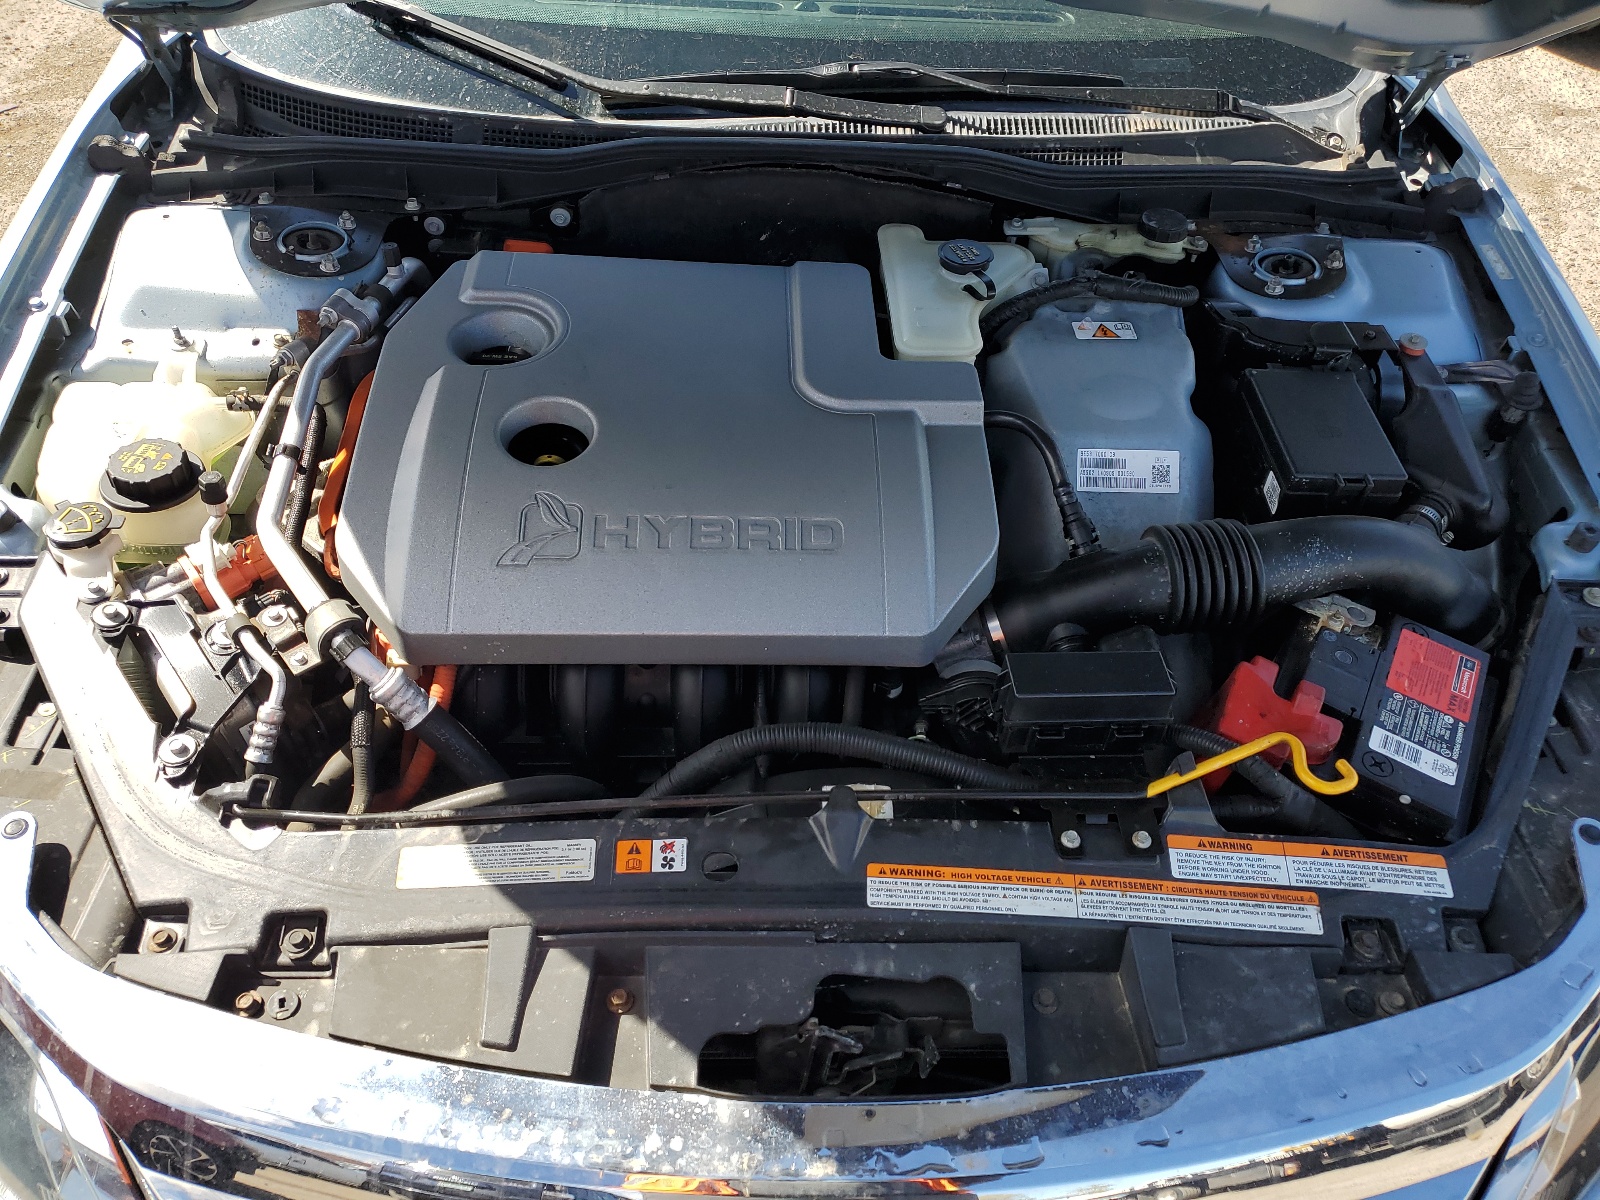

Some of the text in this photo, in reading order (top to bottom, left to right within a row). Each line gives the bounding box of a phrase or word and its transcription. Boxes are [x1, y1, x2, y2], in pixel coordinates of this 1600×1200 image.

[593, 514, 845, 551] HYBRID
[1446, 694, 1458, 712] MAX
[1208, 840, 1253, 851] WARNING
[1333, 848, 1408, 862] AVERTISSEMENT
[889, 868, 946, 878] WARNING:
[1090, 879, 1163, 891] AVERTISSEMENT
